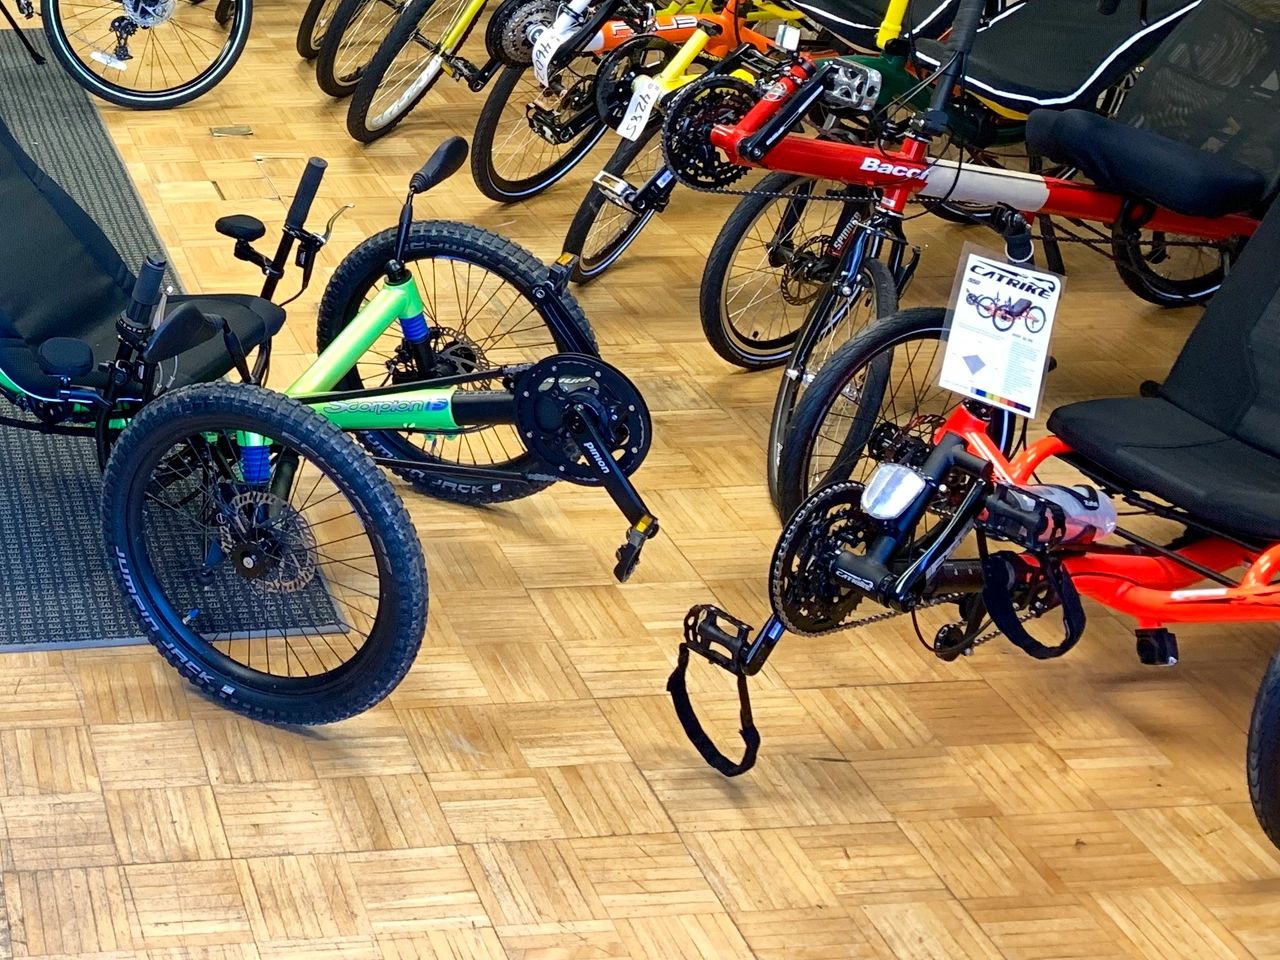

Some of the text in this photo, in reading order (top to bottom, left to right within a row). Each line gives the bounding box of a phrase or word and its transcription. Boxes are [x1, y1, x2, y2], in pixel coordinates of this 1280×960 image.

[970, 265, 1052, 300] CATRIKE
[324, 401, 424, 415] Scorpion
[583, 441, 610, 474] pinion
